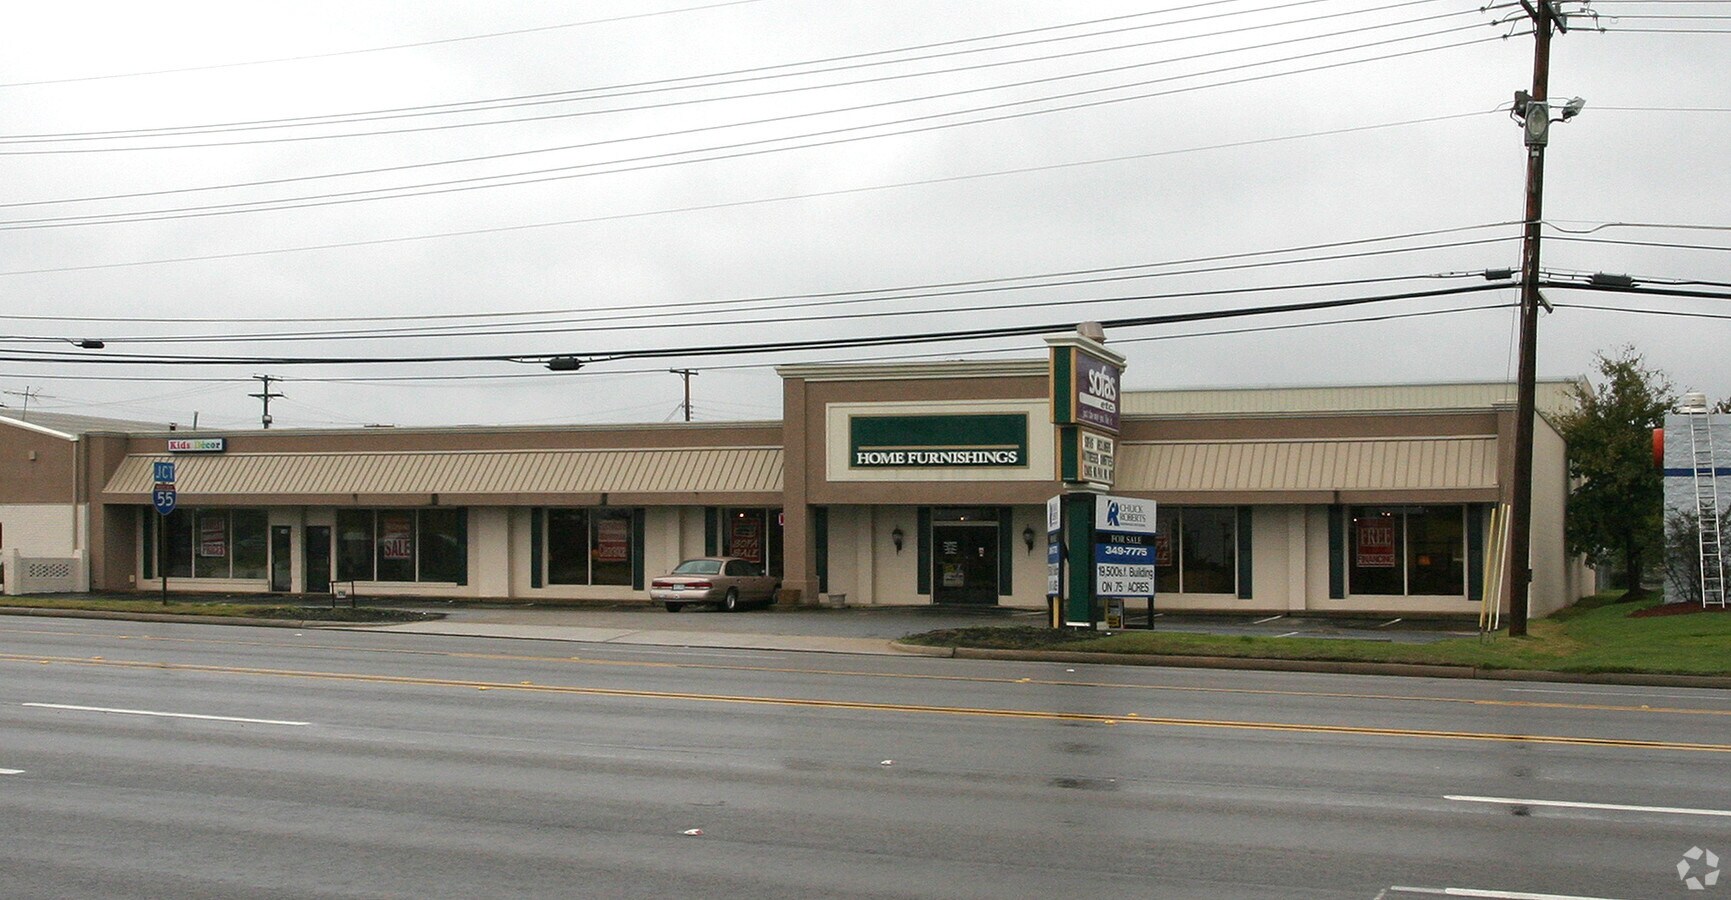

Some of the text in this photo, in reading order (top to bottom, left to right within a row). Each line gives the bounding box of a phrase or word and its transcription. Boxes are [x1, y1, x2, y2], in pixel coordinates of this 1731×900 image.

[1088, 365, 1116, 401] sofas
[170, 441, 191, 449] Kids
[857, 451, 1018, 464] HOME FURNISHINGS
[156, 465, 174, 479] JCT
[157, 491, 173, 506] 55
[1120, 504, 1143, 513] CHUCK
[1120, 513, 1147, 522] ROBERTS
[1111, 535, 1142, 544] FOR SALE
[1360, 528, 1392, 547] FREE
[384, 540, 410, 556] SALE
[733, 539, 758, 548] SOFA
[732, 549, 758, 557] SALE
[1105, 546, 1148, 556] 349-7775
[1129, 566, 1154, 580] Building
[1102, 581, 1113, 592] ON
[1128, 581, 1149, 592] ACRES
